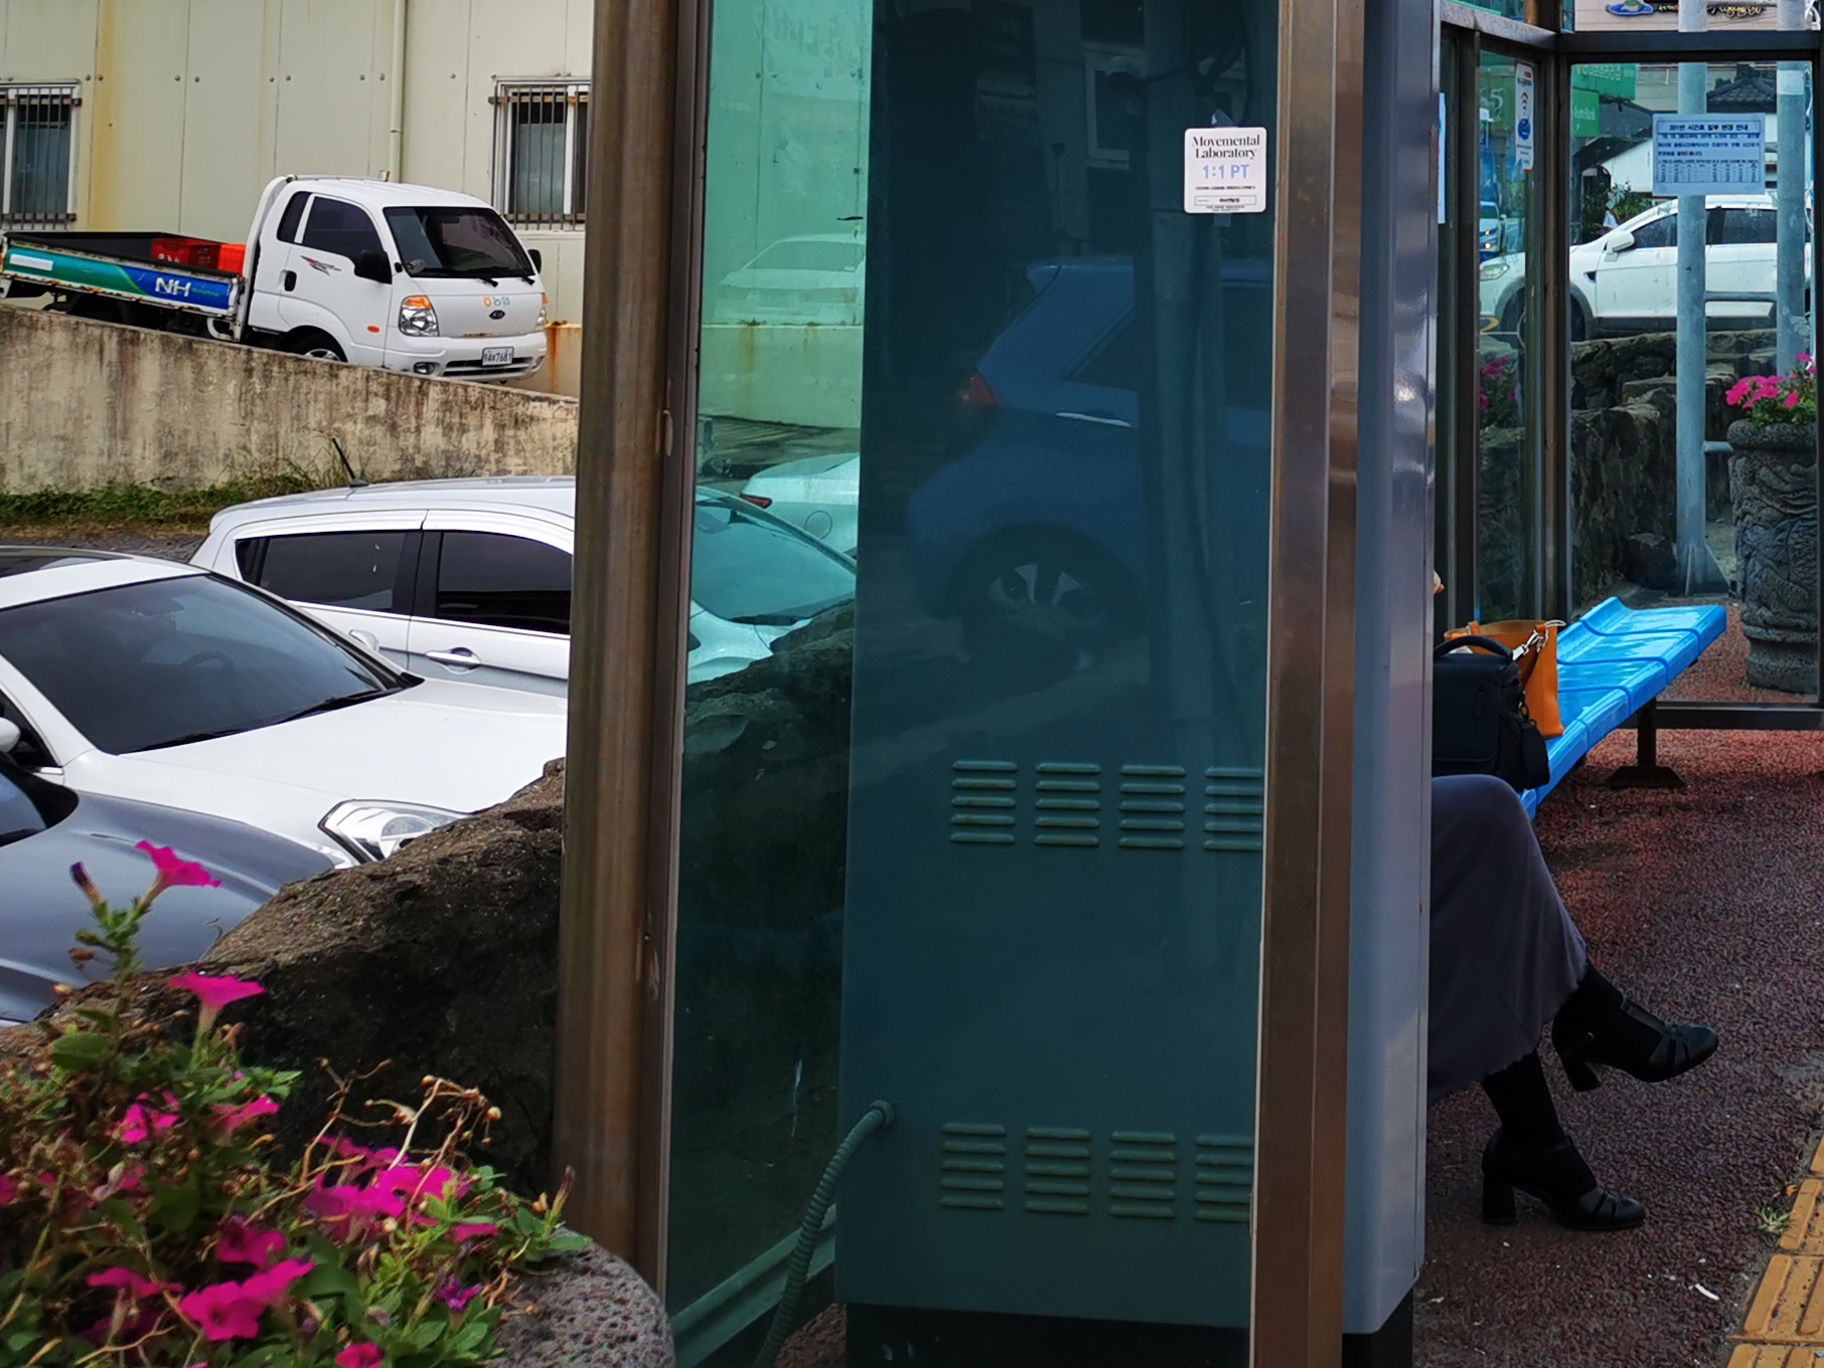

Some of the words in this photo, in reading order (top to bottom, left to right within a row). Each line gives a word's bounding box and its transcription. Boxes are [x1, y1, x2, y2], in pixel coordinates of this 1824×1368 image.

[1192, 134, 1260, 147] Movemental
[1195, 147, 1256, 160] Laboratory
[1203, 164, 1225, 179] 1:1
[1230, 164, 1250, 179] PT
[154, 277, 192, 298] NH
